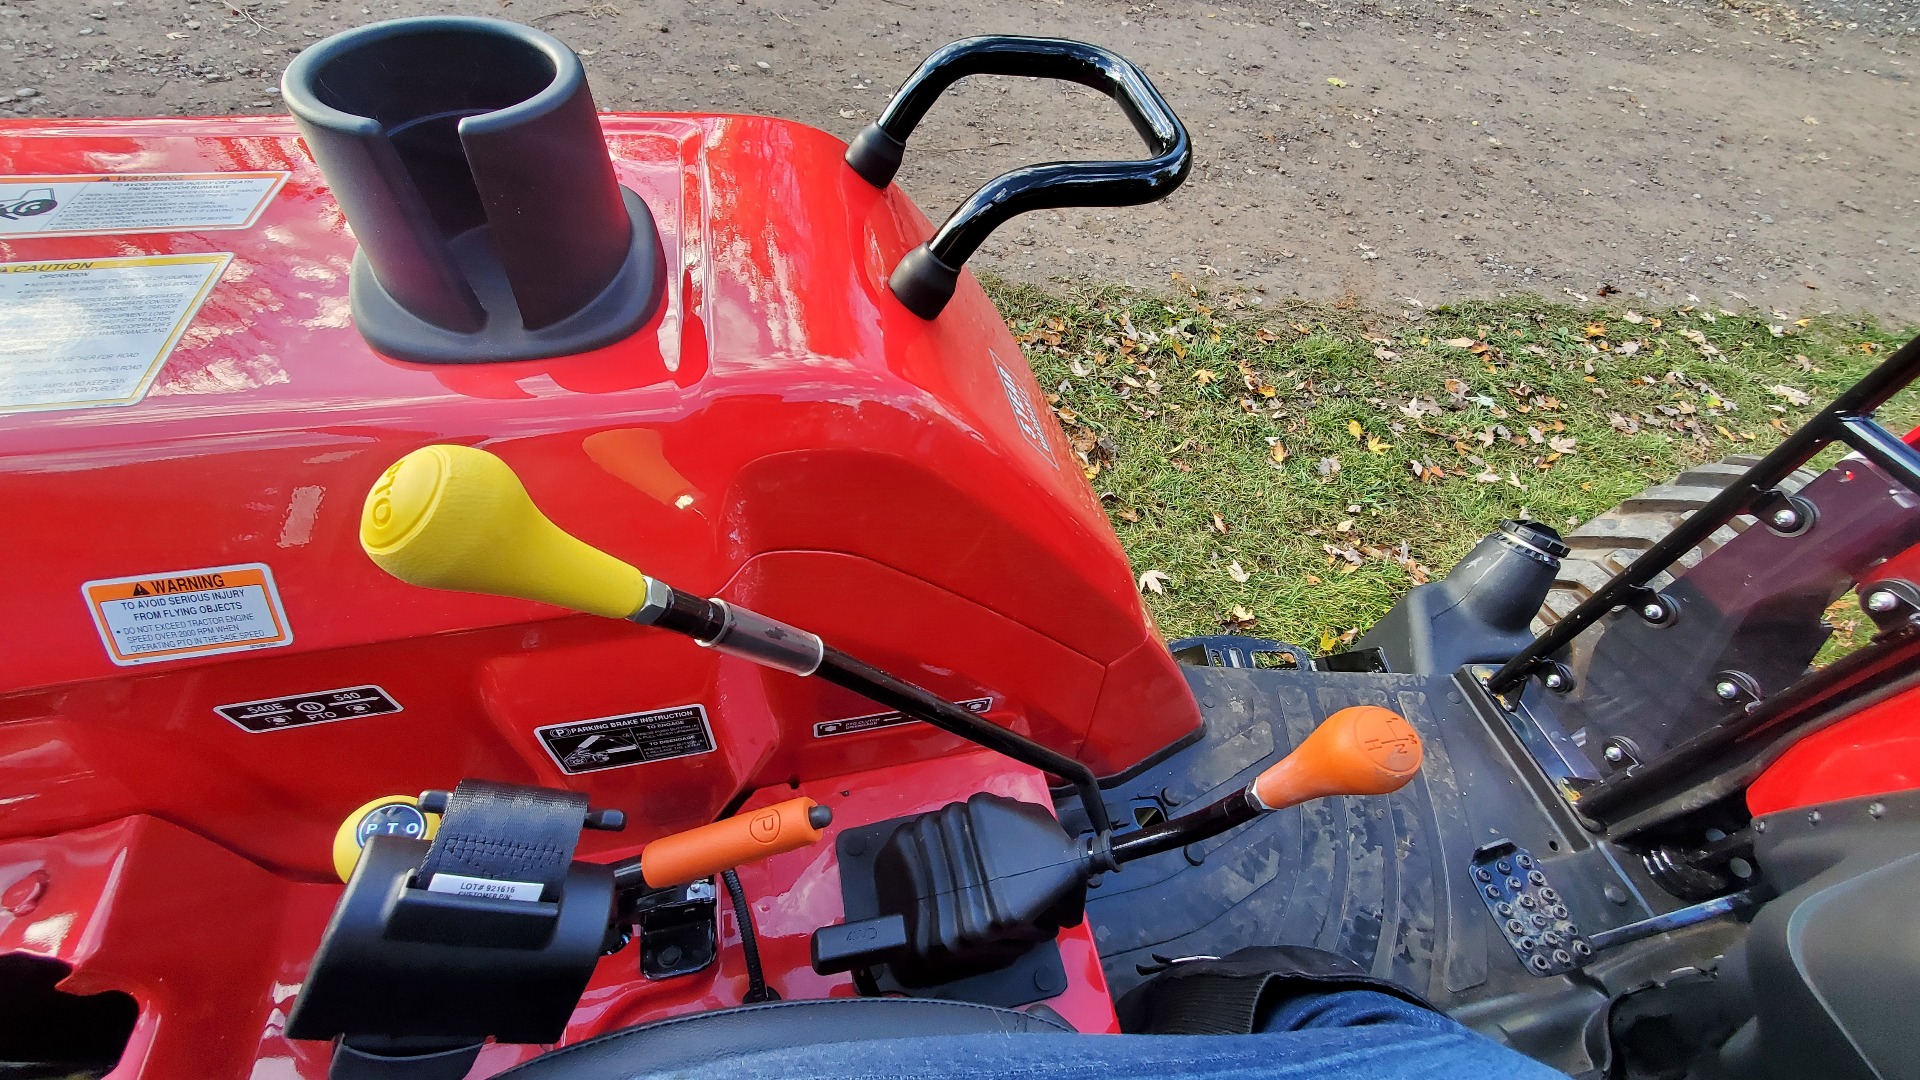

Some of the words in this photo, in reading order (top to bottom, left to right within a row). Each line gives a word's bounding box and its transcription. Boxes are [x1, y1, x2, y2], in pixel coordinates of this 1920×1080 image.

[14, 262, 94, 272] CAUTION
[998, 365, 1030, 422] YEAR
[1019, 418, 1036, 440] 5
[151, 574, 224, 594] WARNING
[121, 602, 135, 610] TO
[138, 597, 166, 609] AVOID
[168, 592, 211, 605] SERIOUS
[212, 589, 245, 600] INJURY
[133, 611, 162, 621] FROM
[163, 607, 197, 618] FLYING
[199, 602, 242, 614] OBJECTS
[123, 627, 136, 635] DO
[137, 625, 152, 633] NOT
[154, 621, 187, 631] EXCEED
[187, 616, 224, 627] TRACTOR
[225, 613, 255, 623] ENGINE
[127, 634, 153, 643] SPEED
[155, 632, 177, 641] OVER
[178, 629, 197, 638] 2000
[197, 627, 215, 635] RPM
[216, 624, 240, 632] WHEN
[131, 640, 176, 652] OPERATING
[177, 638, 193, 647] PTO
[203, 635, 219, 643] THE
[220, 633, 238, 641] 540E
[333, 692, 361, 702] 540
[247, 703, 284, 715] 540E
[306, 711, 337, 722] PTO
[570, 722, 609, 734] PARKING
[610, 718, 639, 728] BRAKE
[640, 710, 693, 724] INSTRUCTION
[657, 720, 685, 728] ENGAGE
[660, 735, 695, 744] DISENGAGE
[755, 814, 774, 831] P
[460, 882, 485, 890] LOT#
[486, 884, 516, 893] 921616
